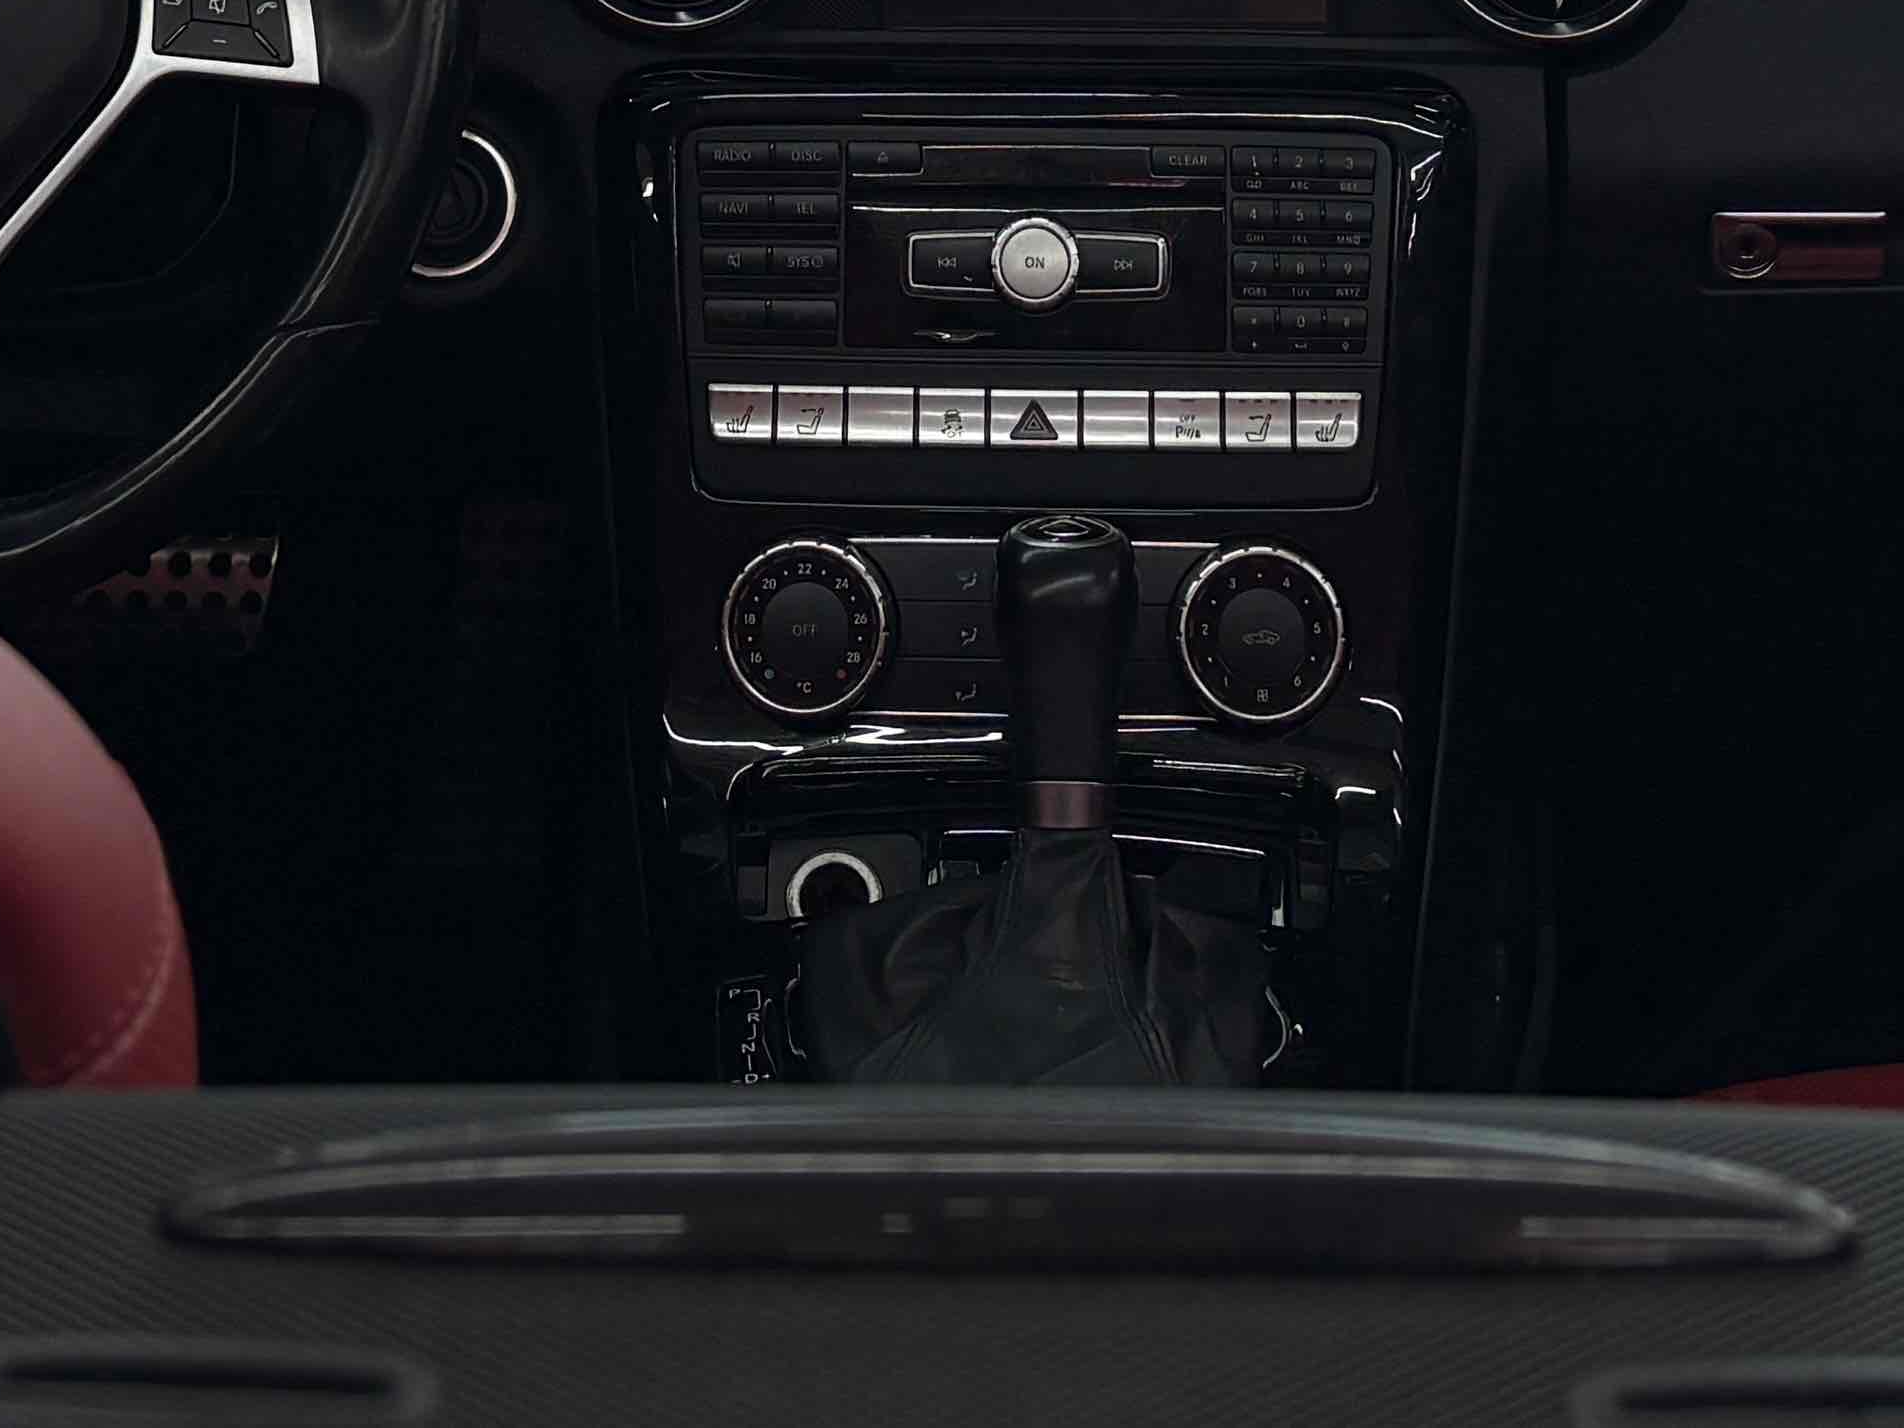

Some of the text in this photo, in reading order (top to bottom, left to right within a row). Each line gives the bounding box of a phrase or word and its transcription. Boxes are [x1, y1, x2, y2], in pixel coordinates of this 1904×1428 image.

[791, 150, 824, 162] DISC
[1168, 155, 1208, 167] CLEAR
[1294, 156, 1304, 168] 2
[1248, 208, 1257, 221] 4
[1025, 256, 1045, 269] ON
[1249, 261, 1258, 273] 7
[797, 563, 813, 575] 22
[762, 578, 777, 590] 20
[834, 578, 849, 590] 24
[1228, 577, 1237, 589] 3
[1282, 577, 1291, 589] 4
[744, 613, 756, 625] 18
[853, 613, 868, 625] 26
[792, 624, 817, 637] OFF
[1201, 623, 1209, 636] 2
[1313, 623, 1322, 634] 5
[750, 651, 763, 663] 16
[847, 651, 861, 664] 28
[796, 681, 812, 693] °C
[1293, 676, 1302, 687] 6
[728, 988, 742, 1000] P
[747, 1012, 761, 1024] R
[741, 1041, 756, 1054] N
[744, 1073, 759, 1084] D
